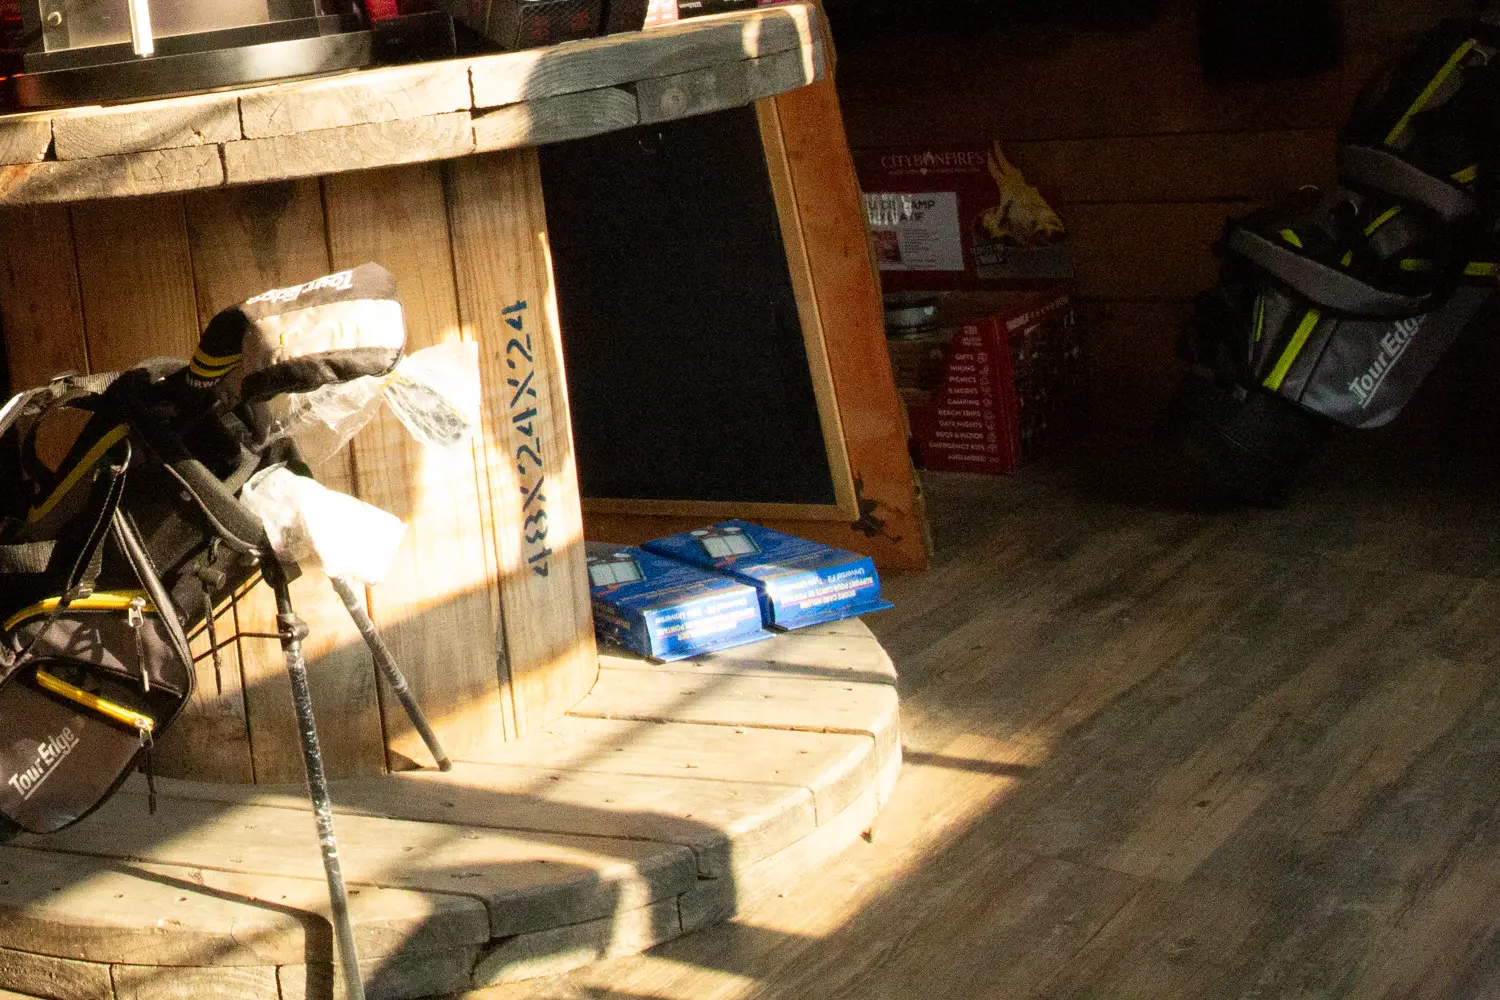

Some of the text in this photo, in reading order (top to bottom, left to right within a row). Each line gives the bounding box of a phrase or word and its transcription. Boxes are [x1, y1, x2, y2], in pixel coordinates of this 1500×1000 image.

[679, 1, 702, 9] Wilson
[501, 299, 553, 578] 48X24X24
[835, 567, 866, 582] Universal
